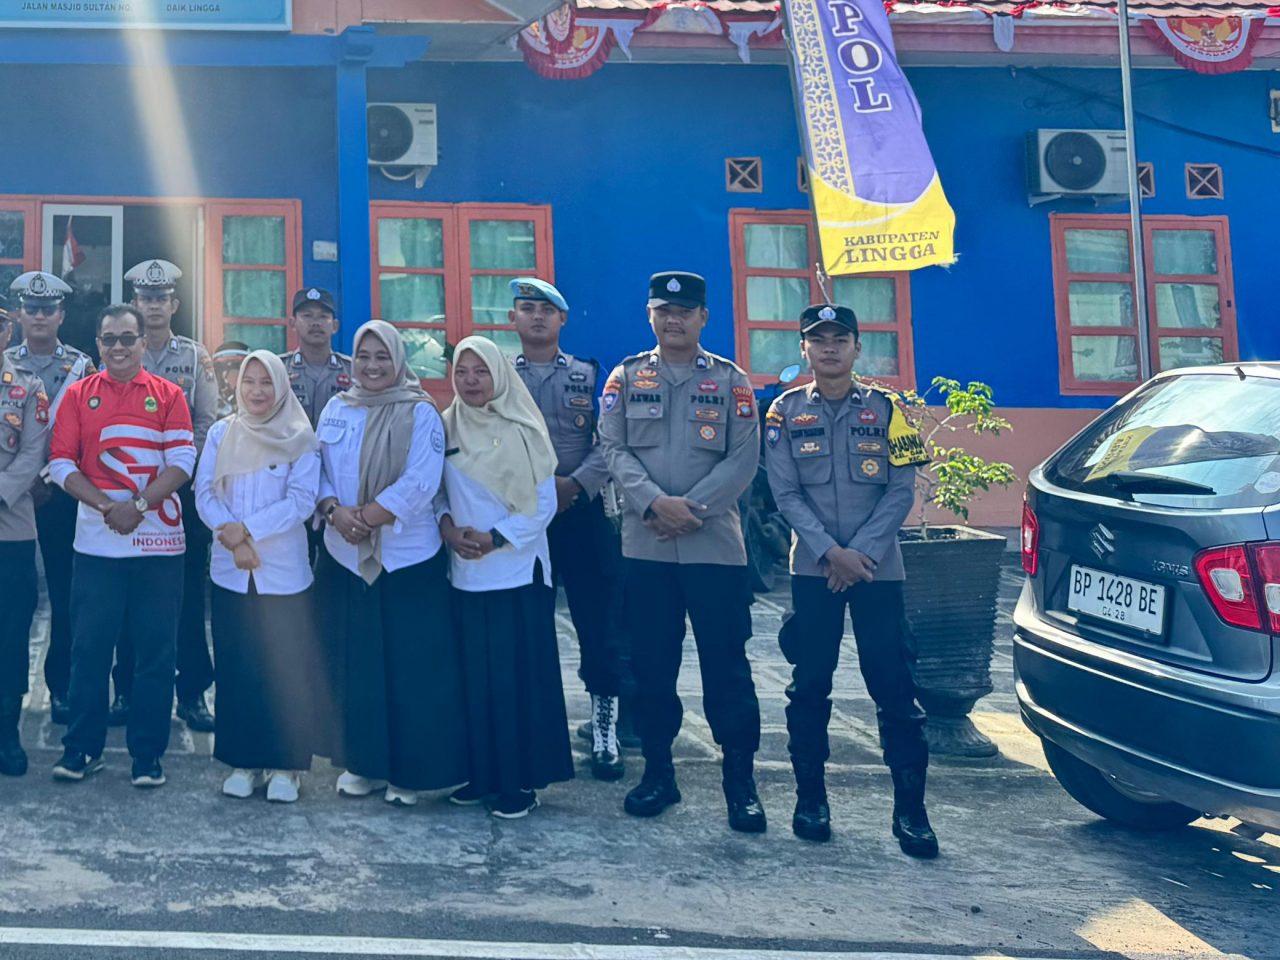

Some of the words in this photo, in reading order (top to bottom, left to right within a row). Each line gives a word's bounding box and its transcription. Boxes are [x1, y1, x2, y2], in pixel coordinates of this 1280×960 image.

[21, 2, 48, 11] JALAN
[83, 3, 116, 12] SULTAN
[189, 4, 220, 13] LINGGA
[844, 231, 940, 247] KABUPATEN
[844, 243, 937, 264] LINGGA
[690, 394, 725, 406] POLRI
[850, 426, 886, 438] POLRI
[1073, 570, 1092, 597] BP
[1096, 576, 1133, 608] 1428
[1138, 586, 1158, 616] BE
